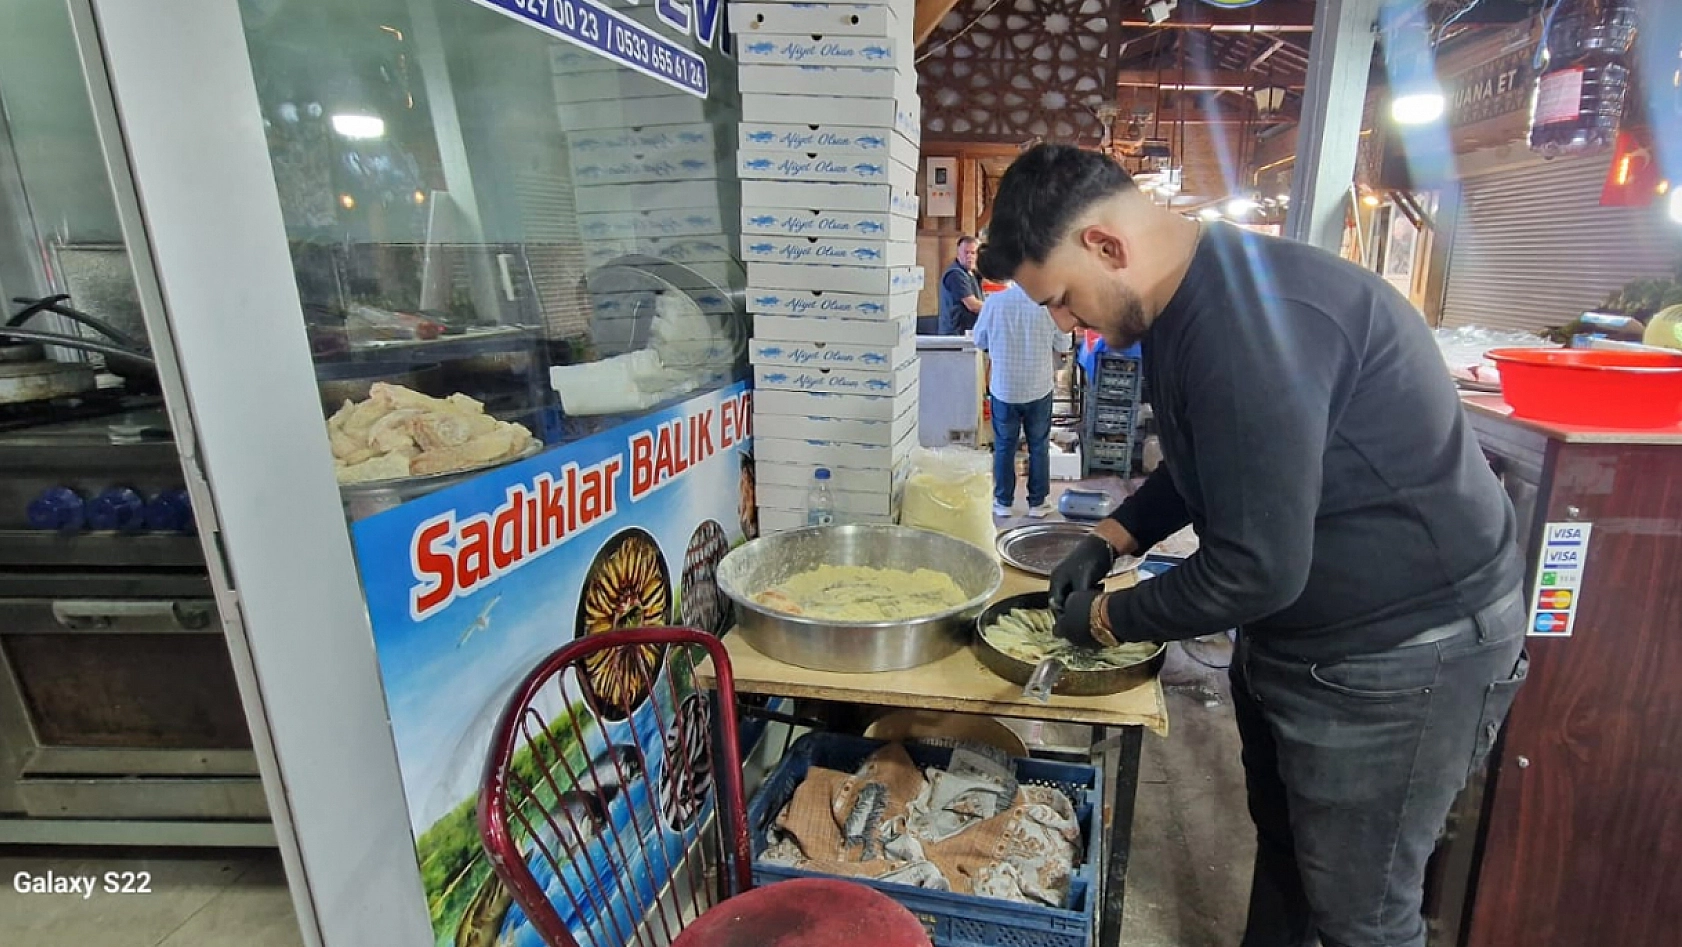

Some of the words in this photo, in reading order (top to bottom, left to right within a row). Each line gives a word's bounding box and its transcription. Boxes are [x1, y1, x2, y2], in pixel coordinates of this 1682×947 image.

[554, 0, 575, 30] 00
[579, 7, 599, 41] 23
[616, 25, 649, 63] 0533
[652, 43, 673, 74] 655
[675, 55, 688, 81] 61
[1497, 69, 1518, 95] ET
[413, 457, 622, 616] Sadıklar
[631, 407, 714, 499] BALIK
[1554, 528, 1581, 538] VISA
[1550, 551, 1578, 561] VISA
